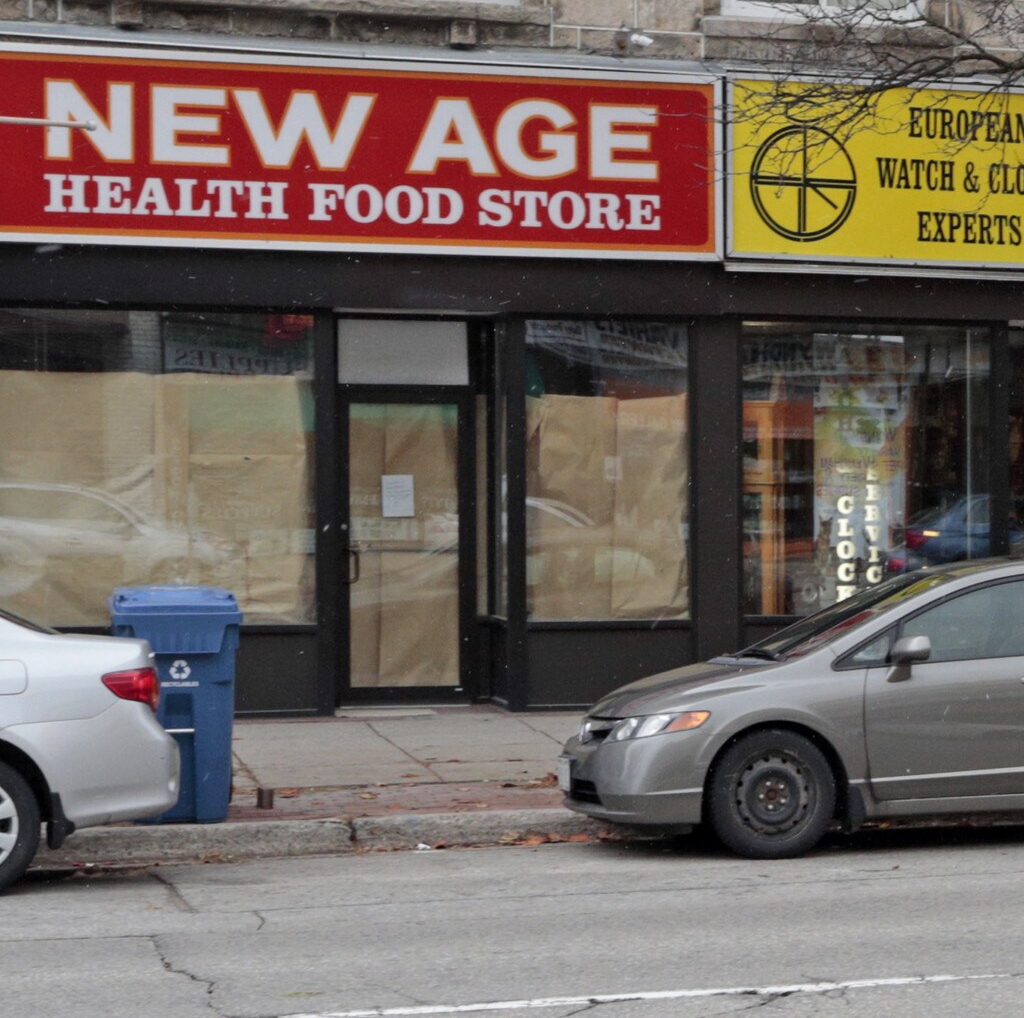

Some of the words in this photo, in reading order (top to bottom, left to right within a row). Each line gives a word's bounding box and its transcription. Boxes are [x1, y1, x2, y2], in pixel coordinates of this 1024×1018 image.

[43, 77, 378, 171] NEW
[405, 95, 660, 182] AGE
[44, 173, 289, 220] HEALTH
[308, 182, 464, 225] FOOD
[478, 189, 661, 231] STORE
[877, 156, 957, 192] WATCH
[963, 161, 980, 192] &
[917, 210, 1023, 247] EXPERTS
[836, 495, 857, 604] CLOCK
